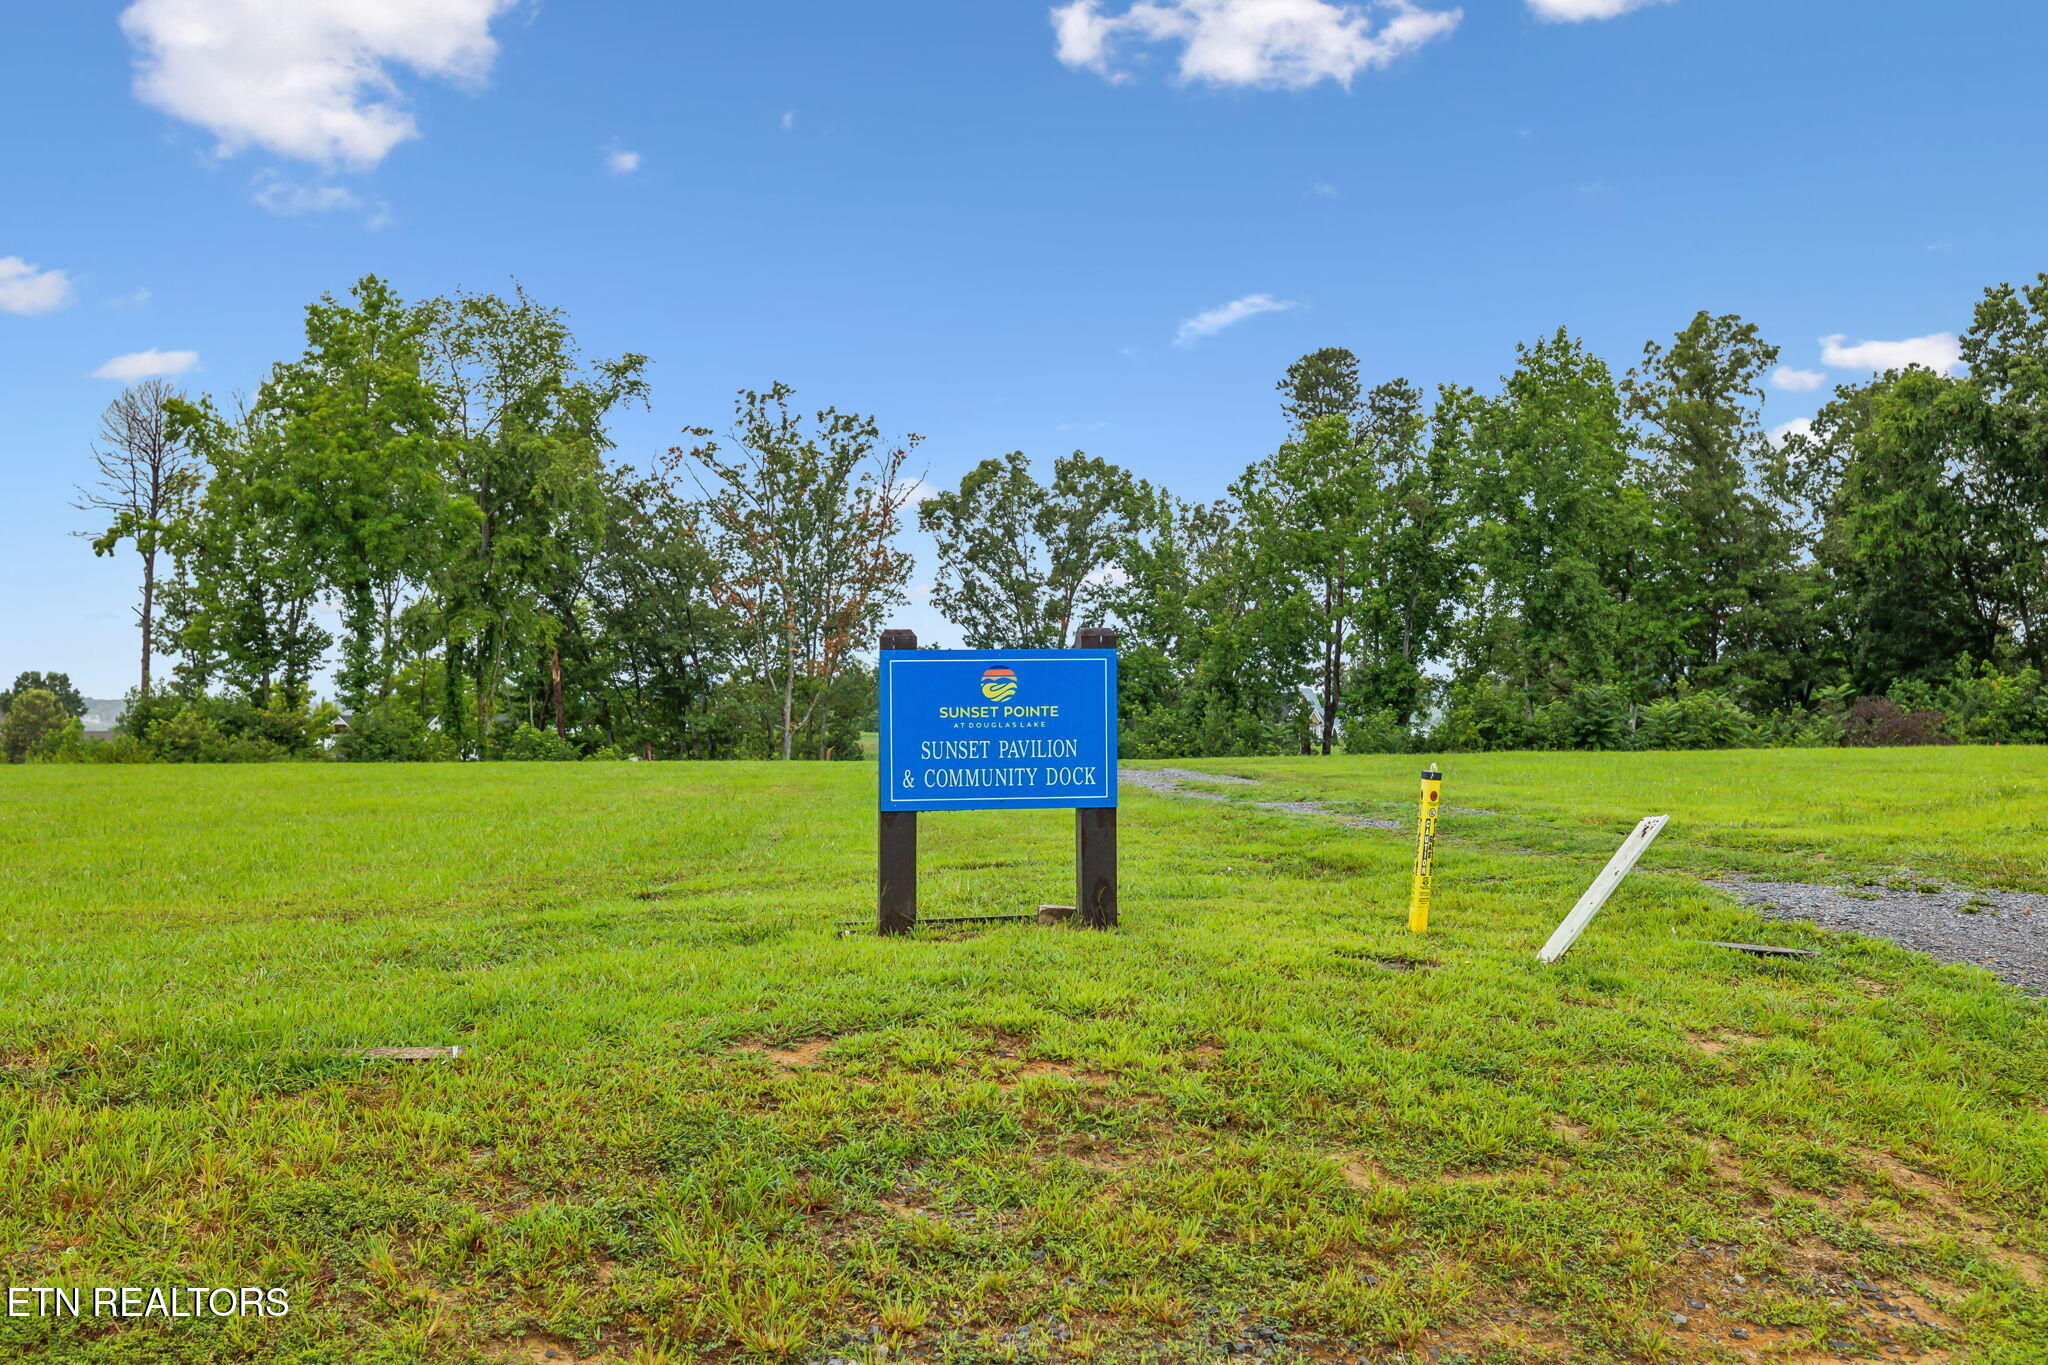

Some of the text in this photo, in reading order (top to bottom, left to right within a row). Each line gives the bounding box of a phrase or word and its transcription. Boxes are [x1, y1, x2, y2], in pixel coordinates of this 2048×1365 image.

[939, 705, 1059, 718] SUNSET POINTE
[968, 721, 1017, 729] DOUGLAS
[921, 739, 1078, 760] SUNSET PAVILION
[902, 767, 1096, 788] & COMMUNITY DOCK
[1421, 819, 1431, 876] CAUTION
